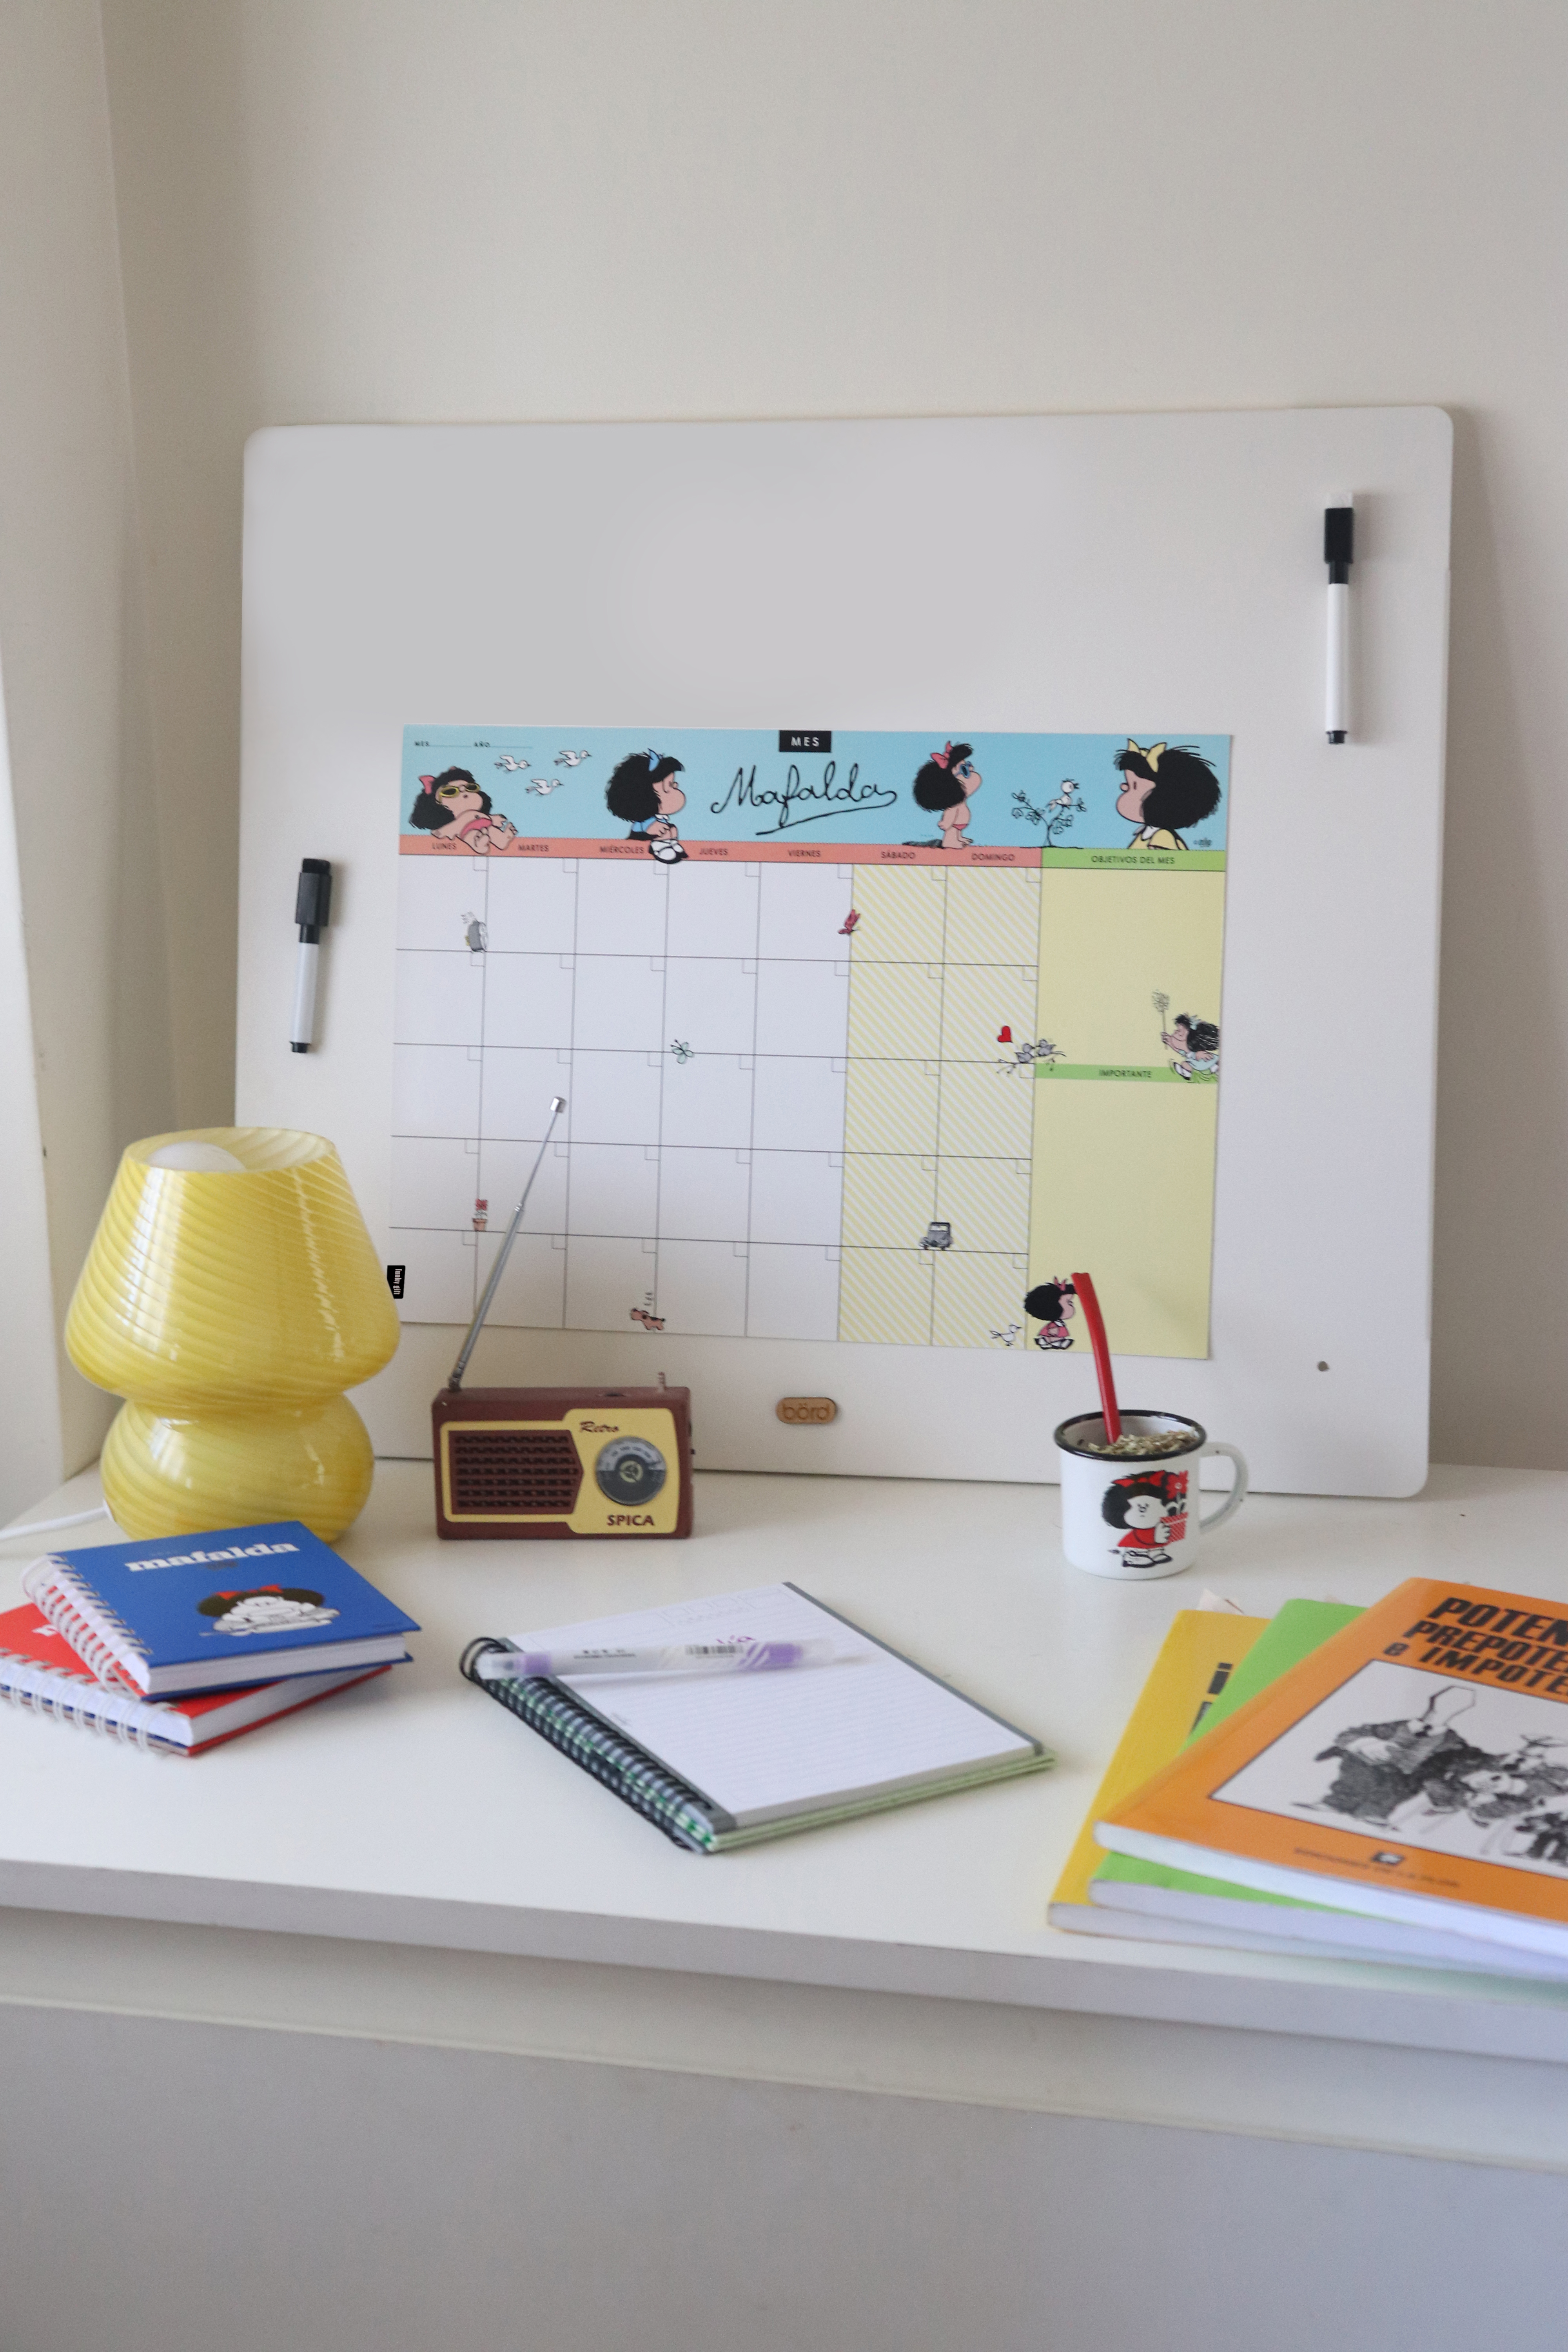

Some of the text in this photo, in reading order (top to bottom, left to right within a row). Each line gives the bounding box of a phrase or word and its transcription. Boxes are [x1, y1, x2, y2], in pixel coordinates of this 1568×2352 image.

[791, 736, 820, 747] MES
[711, 761, 897, 835] Mafalda
[432, 842, 456, 851] LUNES
[600, 844, 644, 855] MIÉRCOLES
[699, 848, 728, 856] JUEVES
[788, 849, 820, 858] VIERNES
[881, 849, 916, 860] SÁBADO
[971, 853, 1015, 862] DOMINGO
[1091, 855, 1137, 864] OBJETIVOS
[1158, 856, 1175, 864] MES
[1099, 1069, 1152, 1078] IMPORTANTE
[392, 1269, 403, 1295] funky gift
[607, 1515, 654, 1526] SPICA
[125, 1543, 300, 1572] mafalda
[1403, 1620, 1568, 1673] PREPOTE
